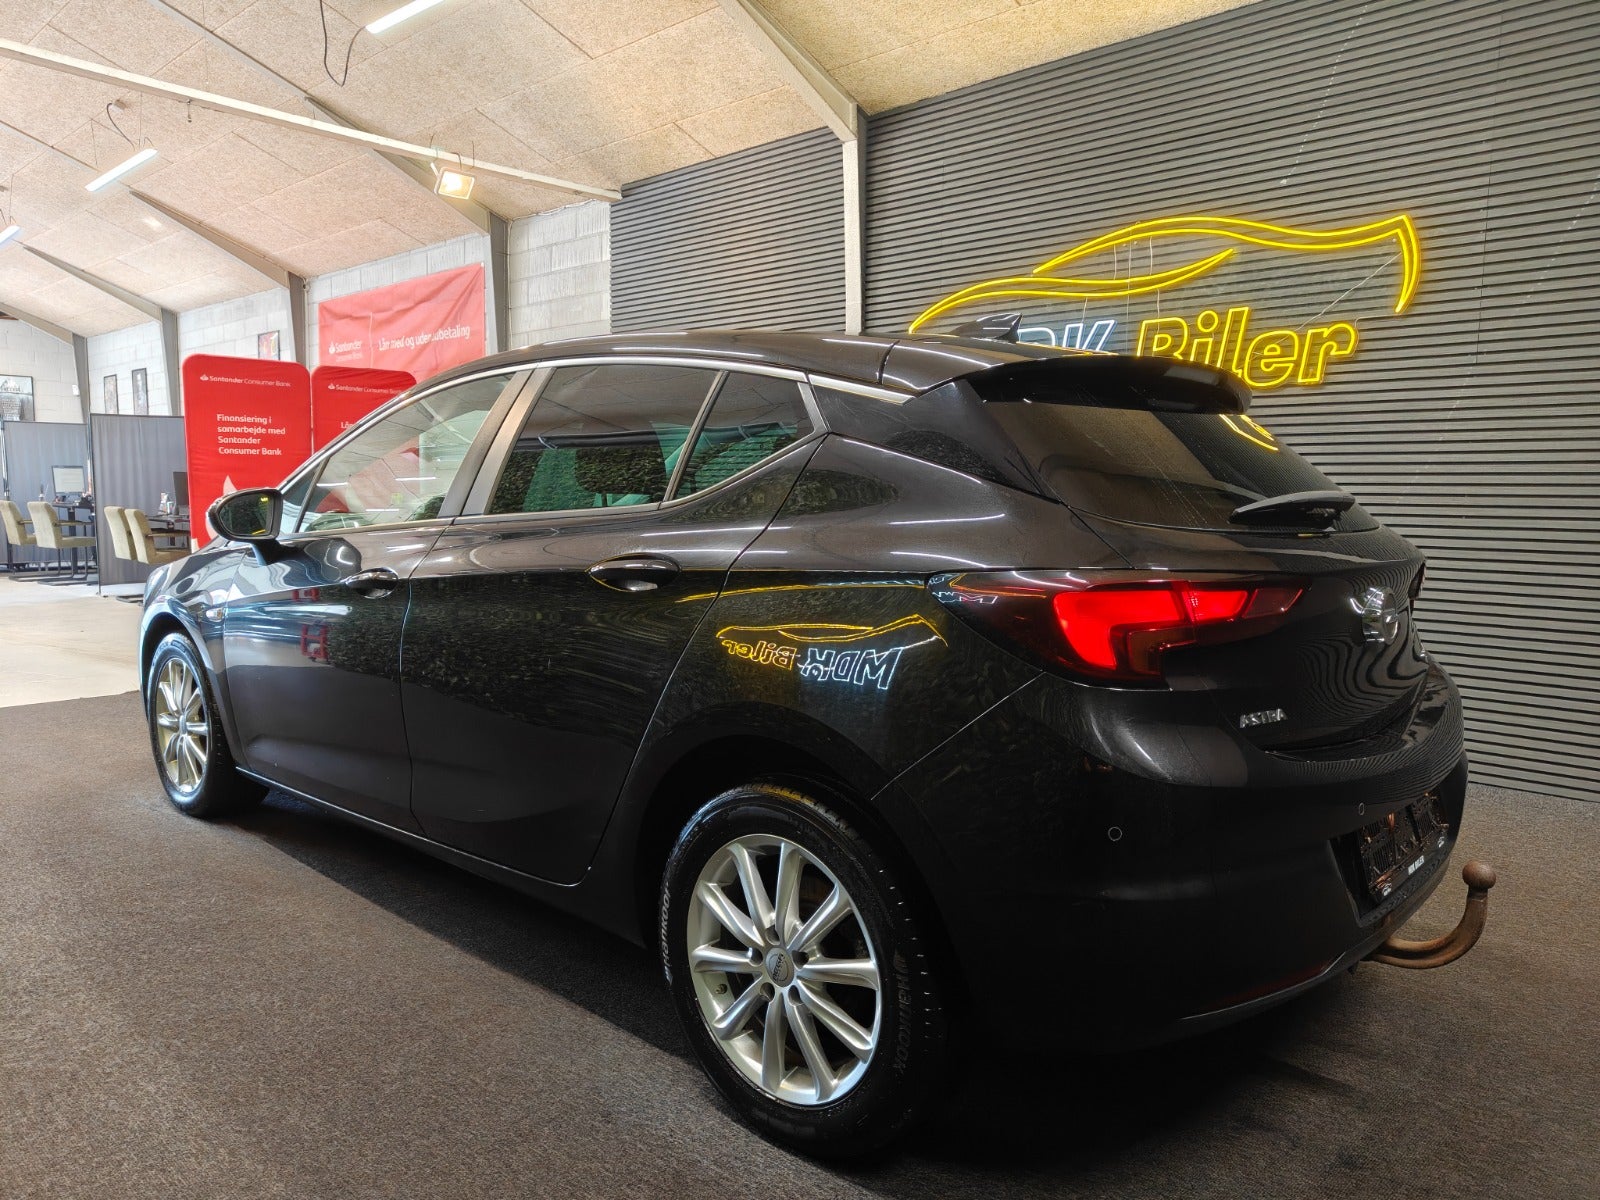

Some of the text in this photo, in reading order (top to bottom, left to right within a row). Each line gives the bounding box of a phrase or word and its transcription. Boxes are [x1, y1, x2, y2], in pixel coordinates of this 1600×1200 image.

[405, 336, 415, 350] og
[1136, 306, 1357, 388] Biler
[209, 375, 243, 384] Santander
[244, 379, 275, 387] Consumer
[335, 384, 363, 392] Santander
[216, 413, 268, 425] Finansiering
[217, 425, 286, 435] samarbejde med
[218, 436, 261, 444] Santander
[219, 446, 282, 456] Consumer Bank
[1239, 708, 1288, 729] ASTRA
